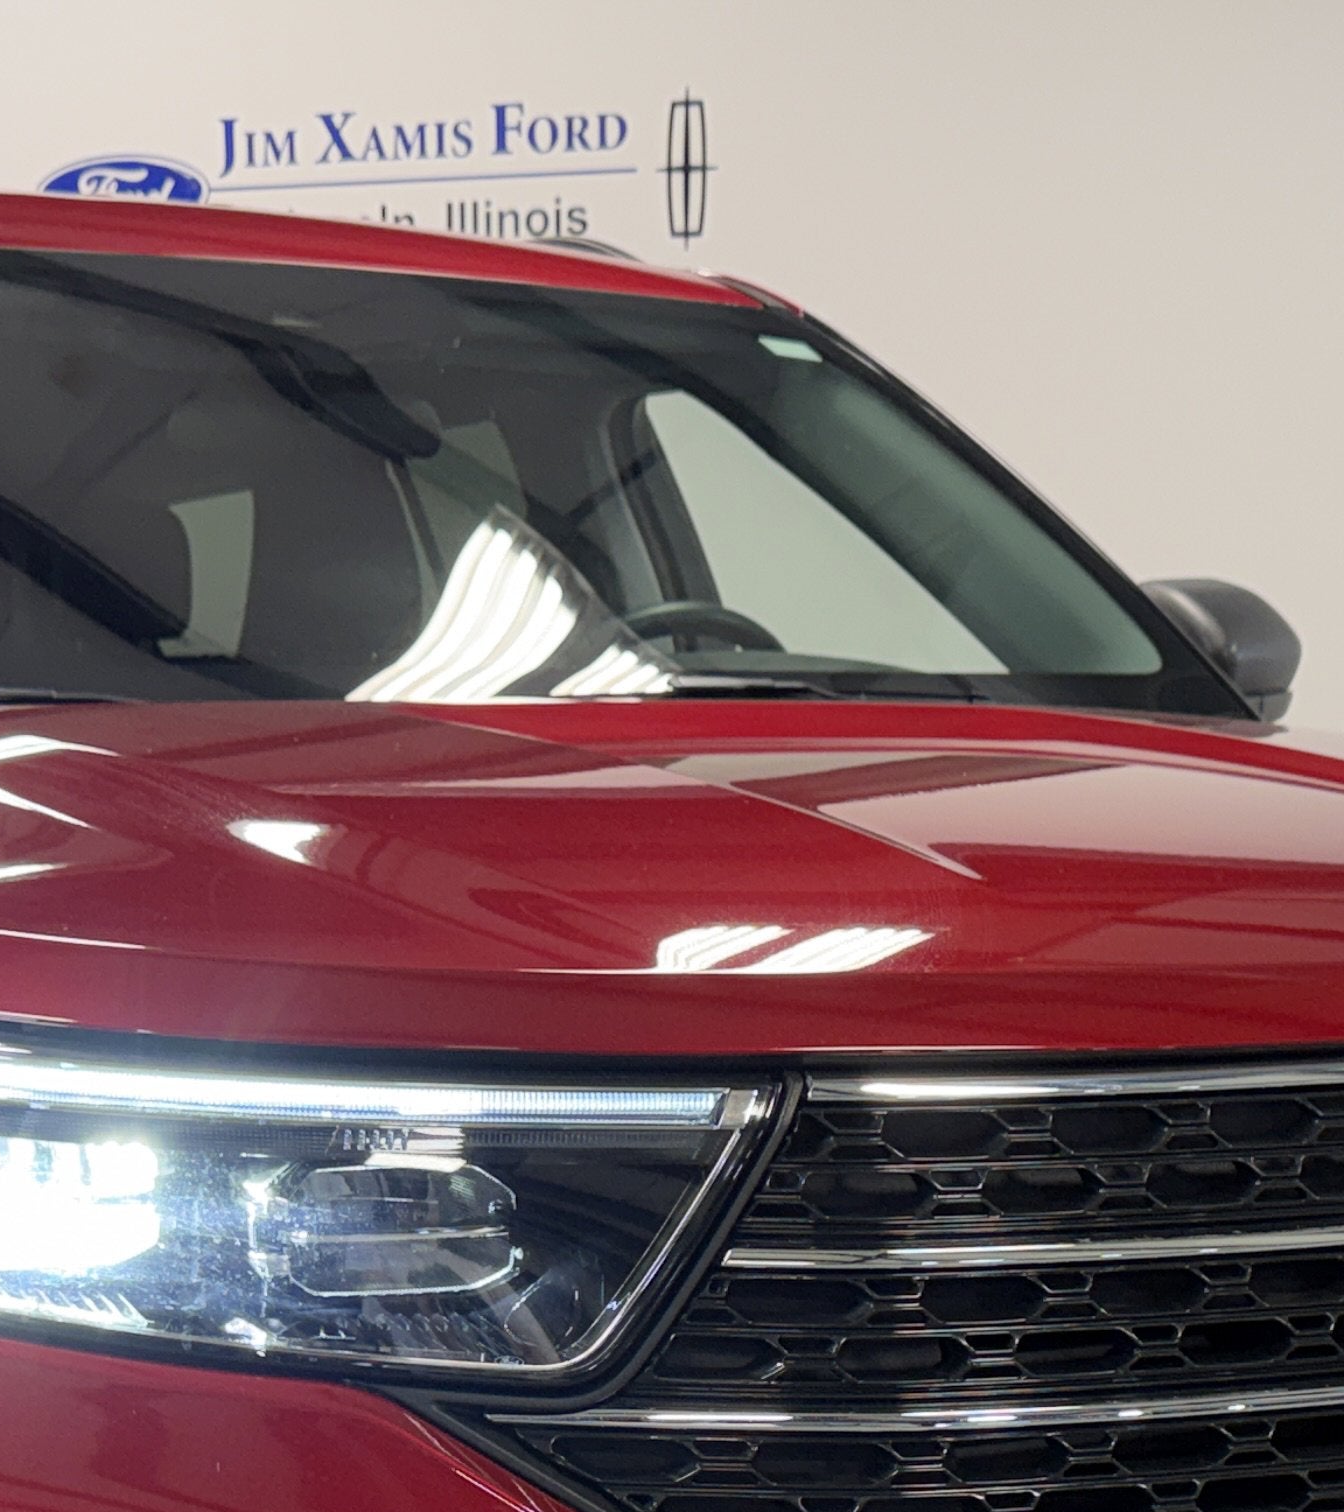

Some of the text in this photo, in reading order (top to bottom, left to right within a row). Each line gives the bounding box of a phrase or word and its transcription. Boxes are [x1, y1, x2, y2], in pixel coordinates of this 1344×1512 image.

[218, 102, 627, 178] JIM XAMIS FORD
[446, 197, 588, 237] Illinois
